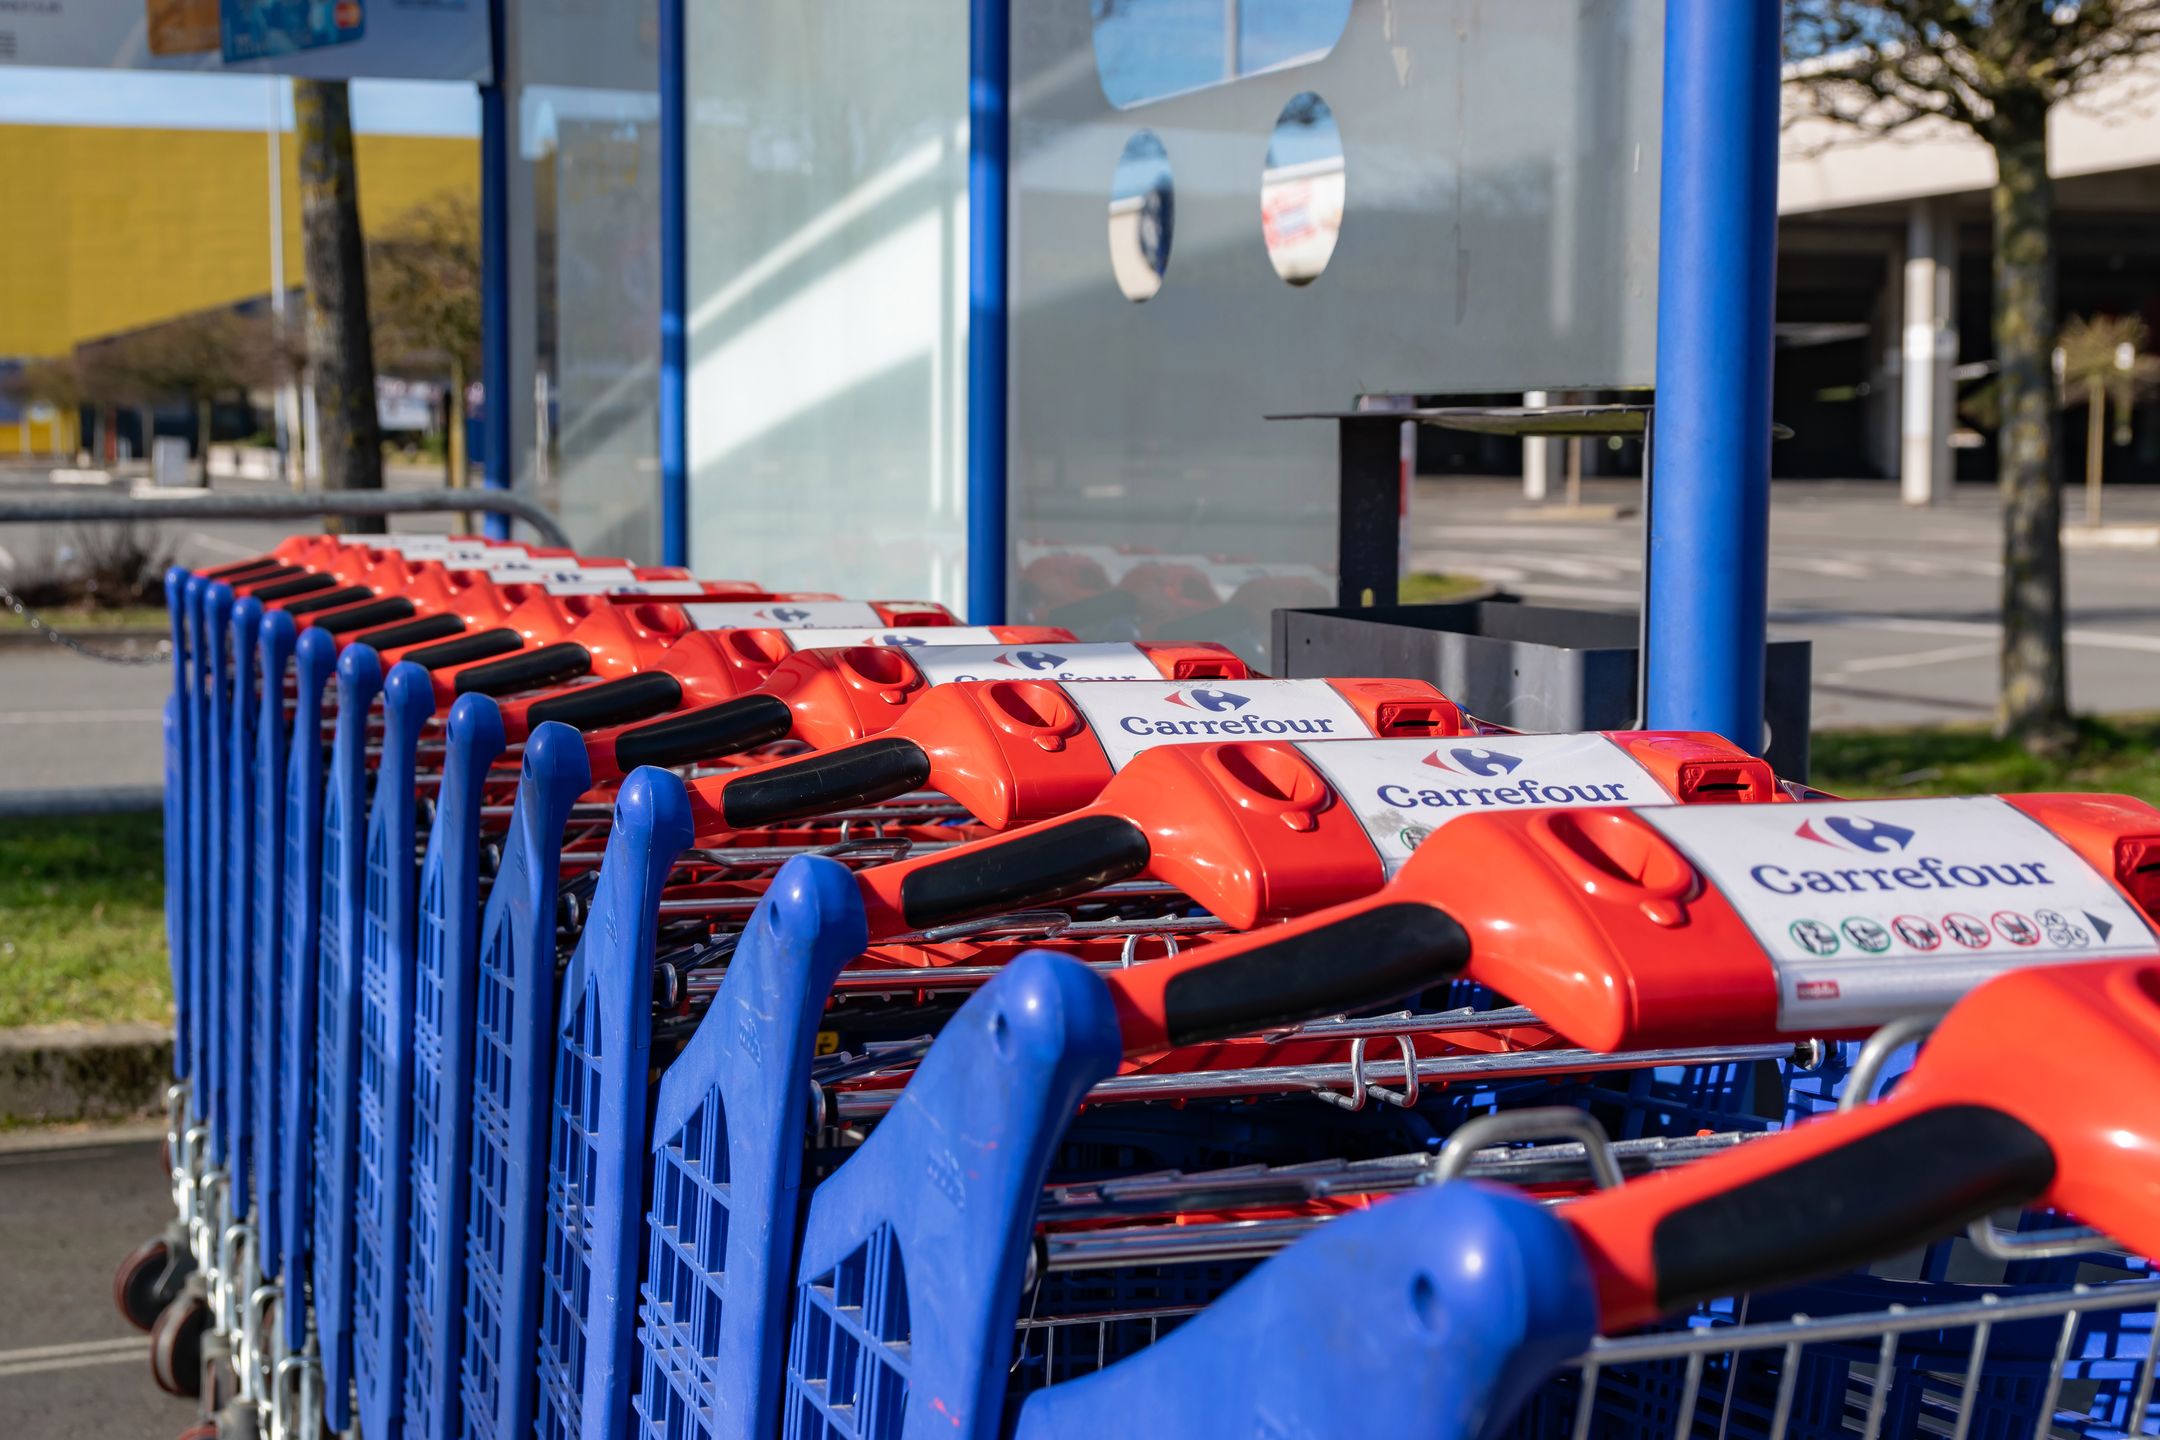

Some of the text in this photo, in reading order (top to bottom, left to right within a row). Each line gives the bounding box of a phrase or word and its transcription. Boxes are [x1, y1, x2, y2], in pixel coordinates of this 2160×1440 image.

[1119, 714, 1334, 736] Carrefour
[1376, 779, 1629, 808] Carrefour
[1750, 857, 2053, 895] Carrefour
